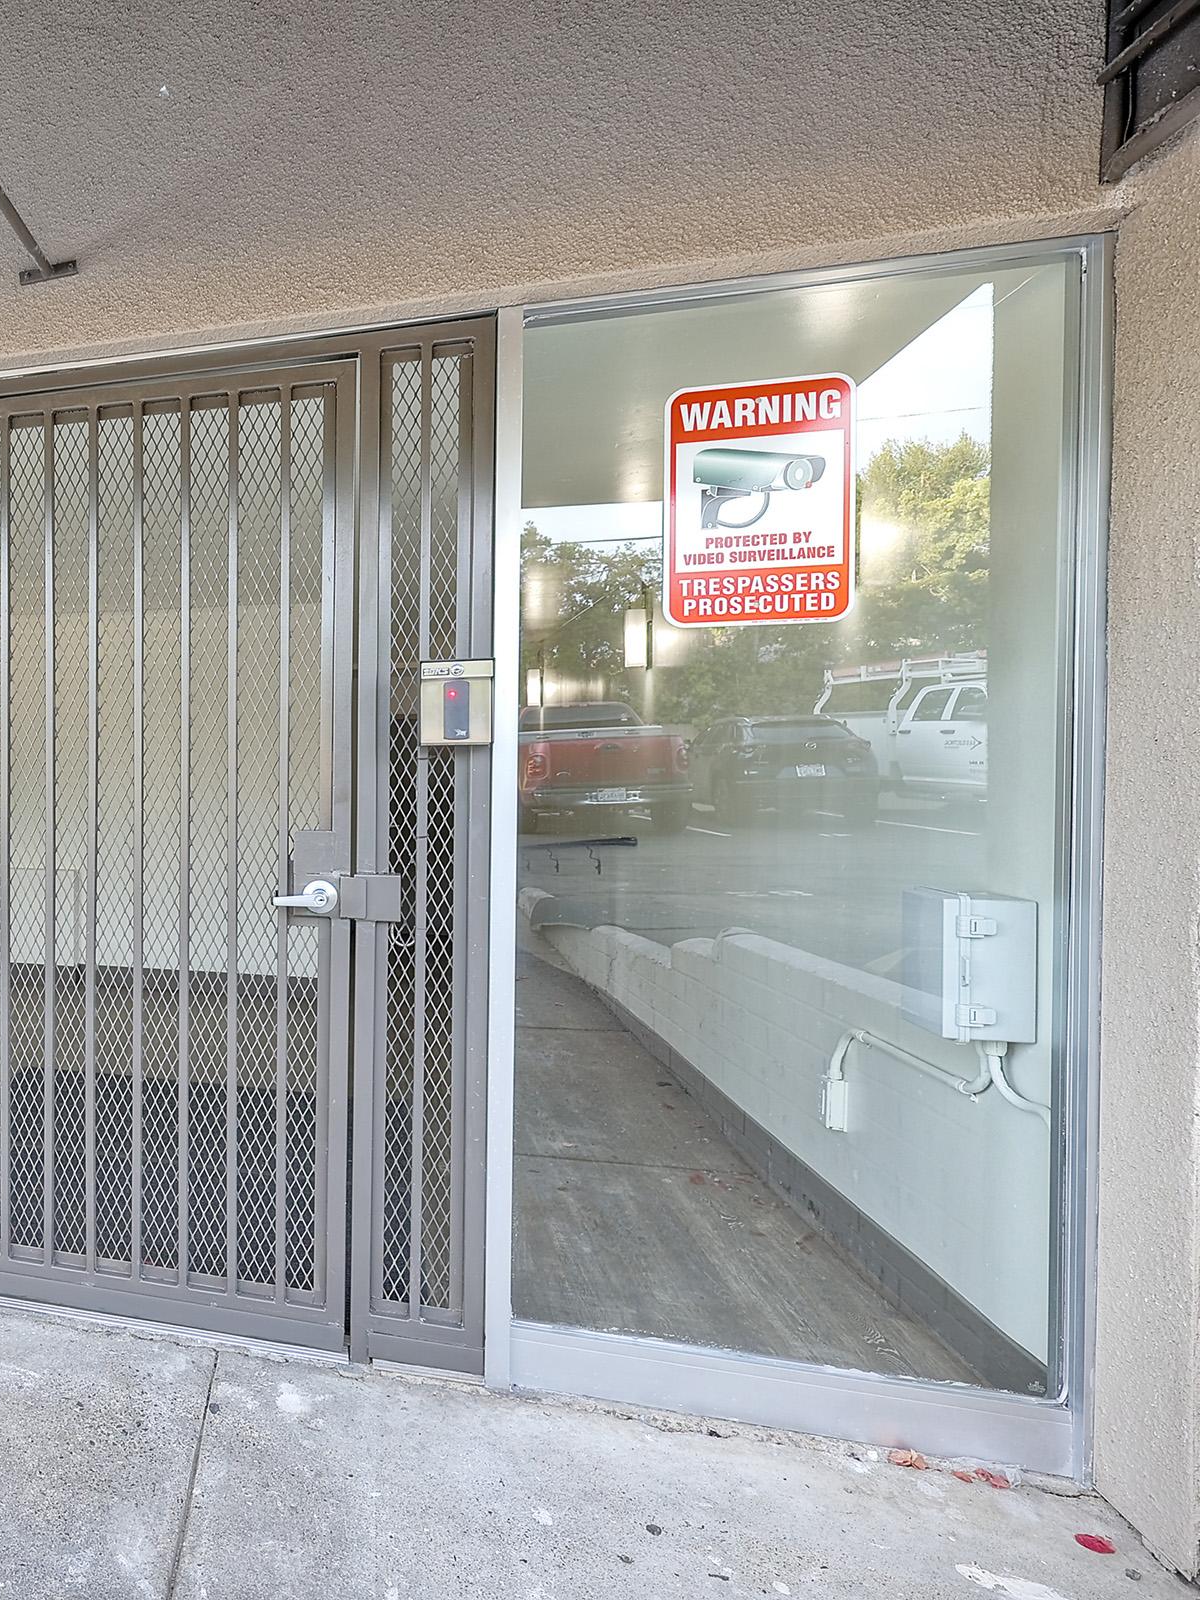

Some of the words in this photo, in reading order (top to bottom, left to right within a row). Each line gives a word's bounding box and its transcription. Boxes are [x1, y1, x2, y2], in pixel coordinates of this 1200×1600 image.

[680, 389, 842, 432] WARNING
[705, 532, 788, 550] PROTECTED
[792, 530, 812, 544] BY
[683, 550, 725, 566] VIDEO
[729, 545, 835, 563] SURVEILLANCE
[679, 571, 840, 597] TRESPASSERS
[683, 592, 835, 616] PROSECUTED
